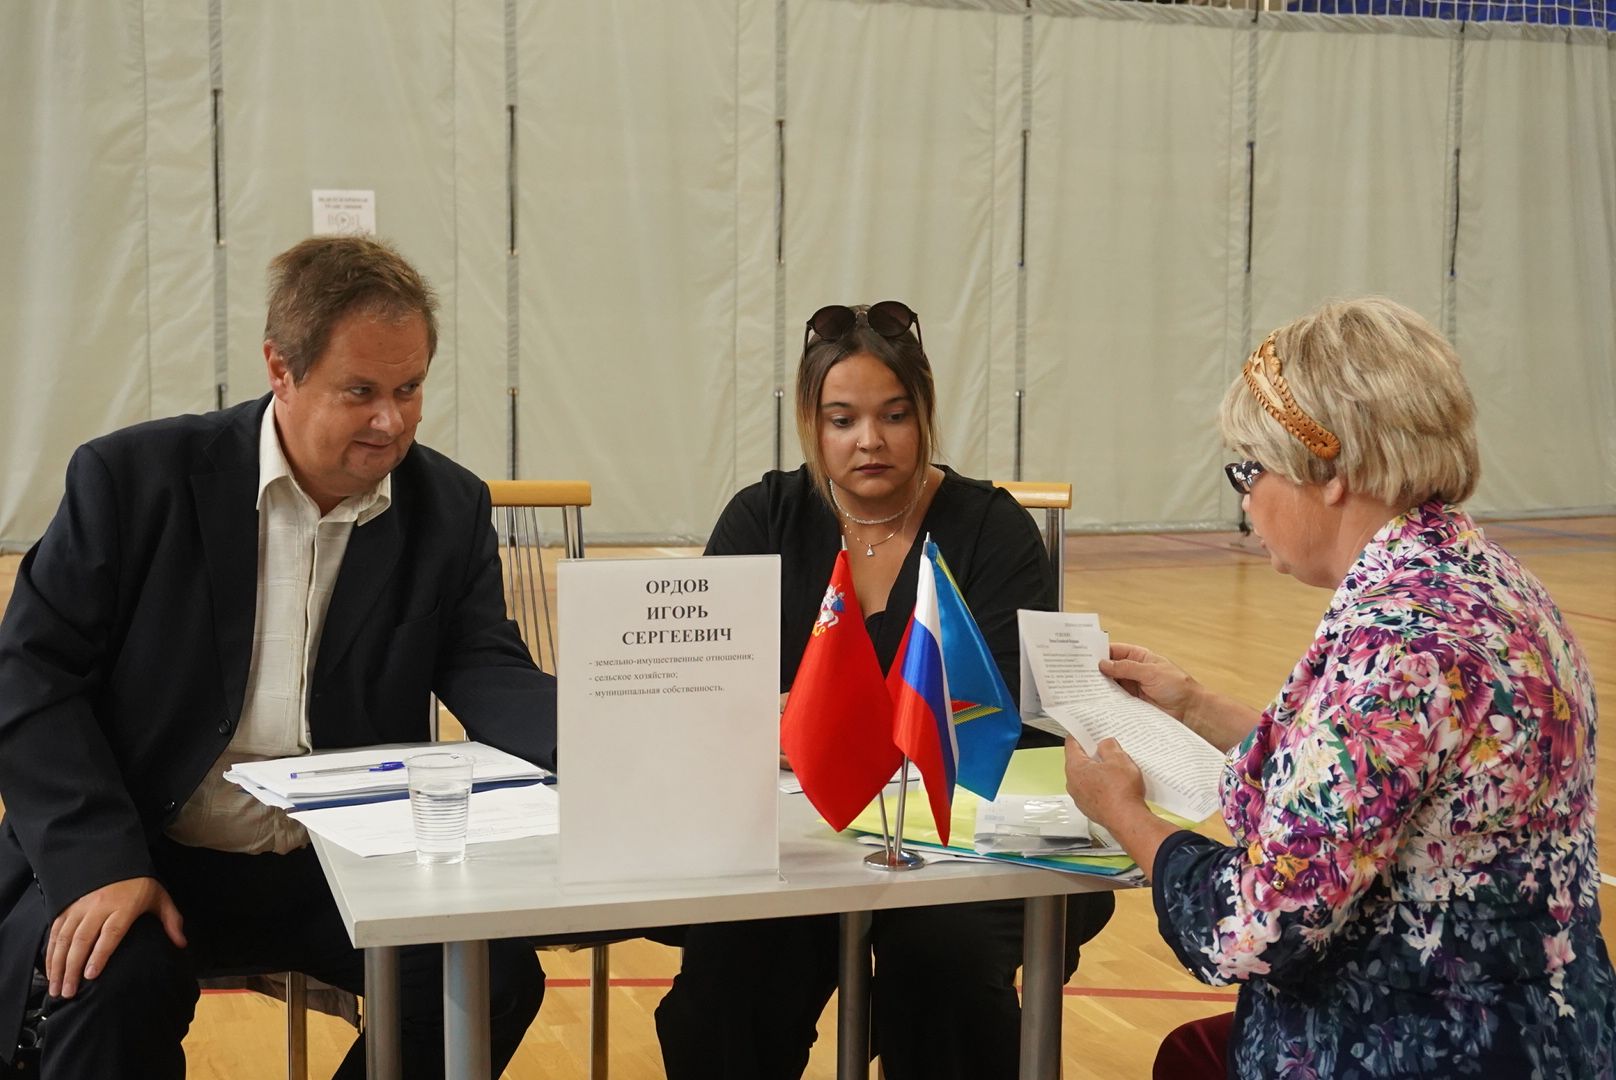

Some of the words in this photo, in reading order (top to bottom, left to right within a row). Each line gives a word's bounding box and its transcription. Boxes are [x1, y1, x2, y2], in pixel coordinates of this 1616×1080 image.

[646, 578, 709, 595] ОРДОВ
[647, 605, 708, 620] ИГОРЬ
[622, 628, 732, 645] СЕРГЕЕВИЧ
[595, 655, 704, 667] земельно-имущественные
[706, 654, 754, 662] отношения;
[595, 672, 631, 681] сельское
[634, 670, 678, 680] хозяйство;
[595, 687, 660, 698] муниципальная
